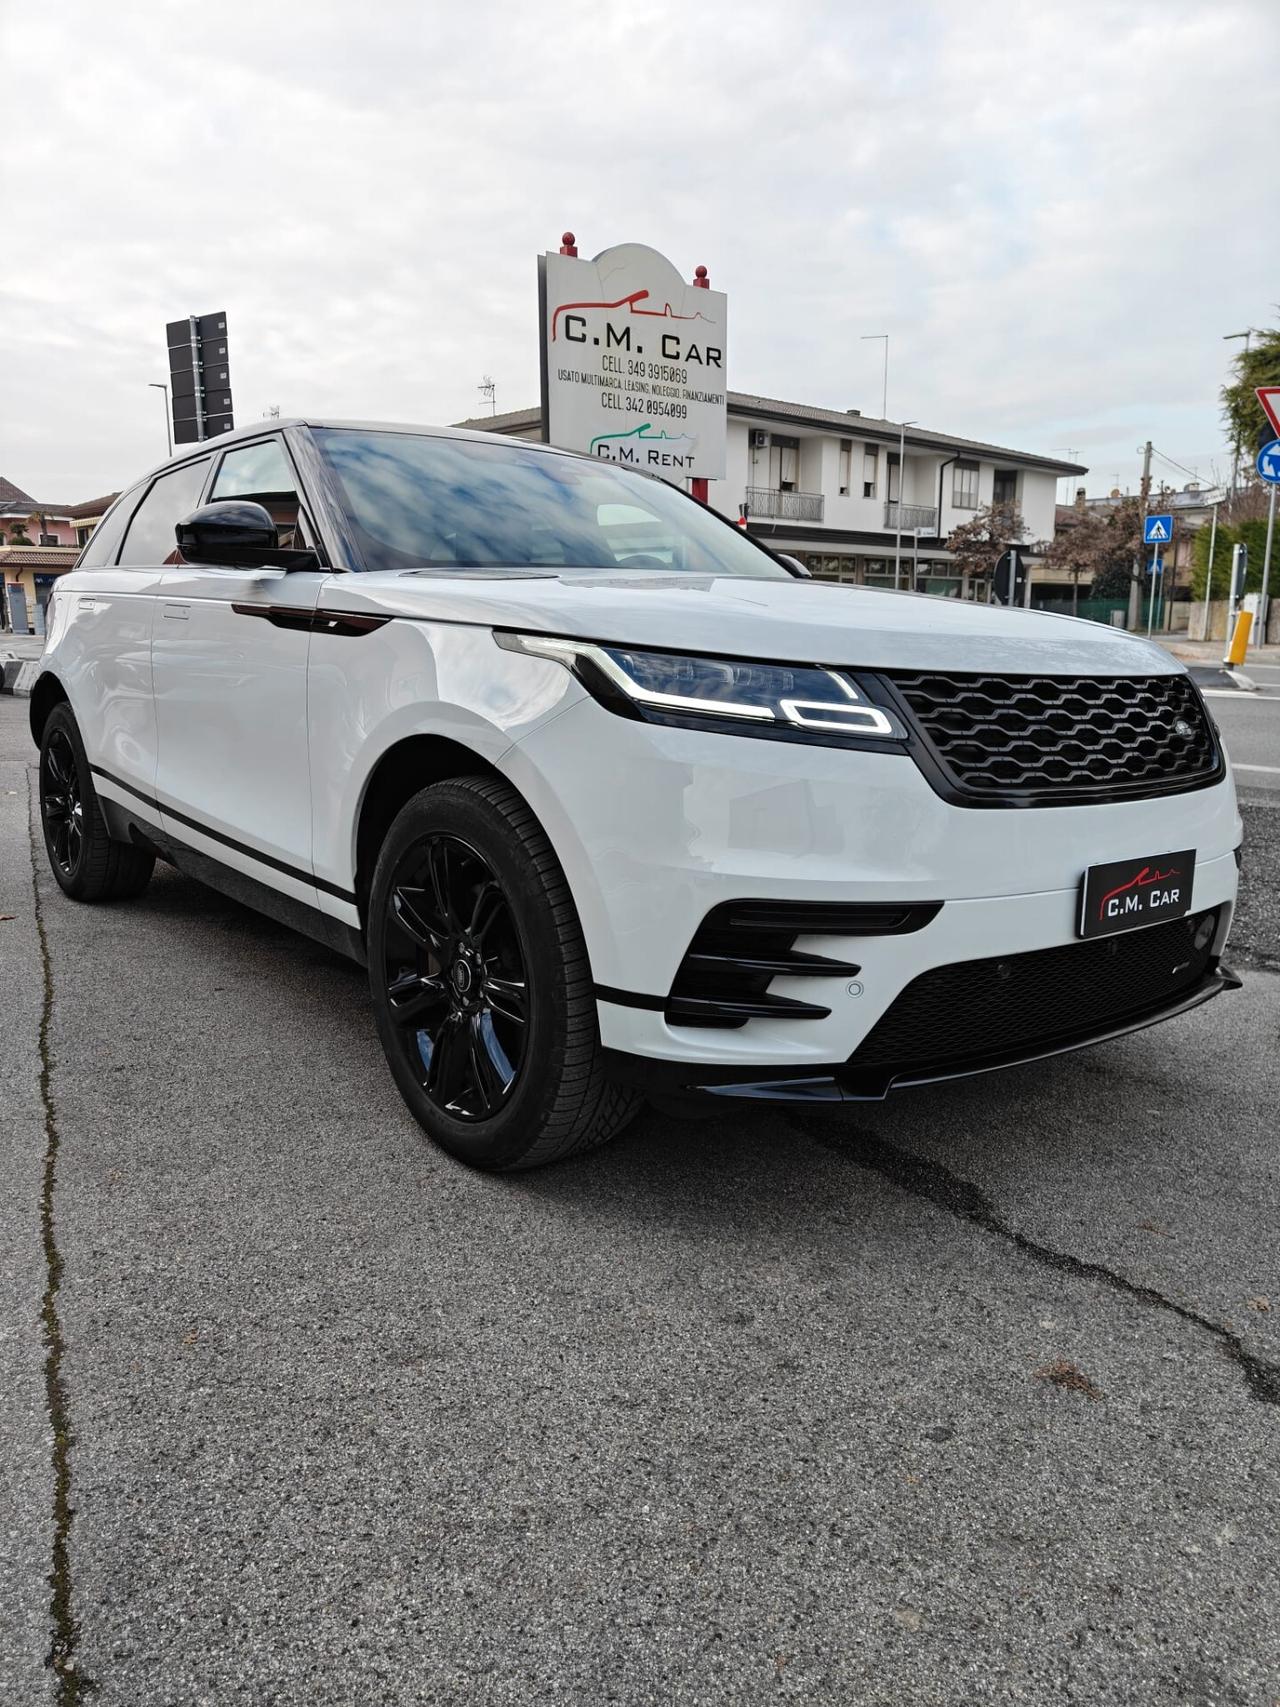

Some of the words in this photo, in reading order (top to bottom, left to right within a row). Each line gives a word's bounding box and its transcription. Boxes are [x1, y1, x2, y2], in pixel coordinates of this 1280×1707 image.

[565, 315, 642, 353] C.M.
[602, 355, 625, 374] CELL.
[628, 360, 646, 377] 349
[647, 363, 688, 384] 3915069
[558, 368, 580, 383] USATO
[682, 390, 725, 406] FINANZIAMENTI
[601, 392, 624, 411] CELL.
[626, 396, 645, 414] 342
[646, 400, 688, 419] 0954099
[1108, 894, 1143, 917] C.M.
